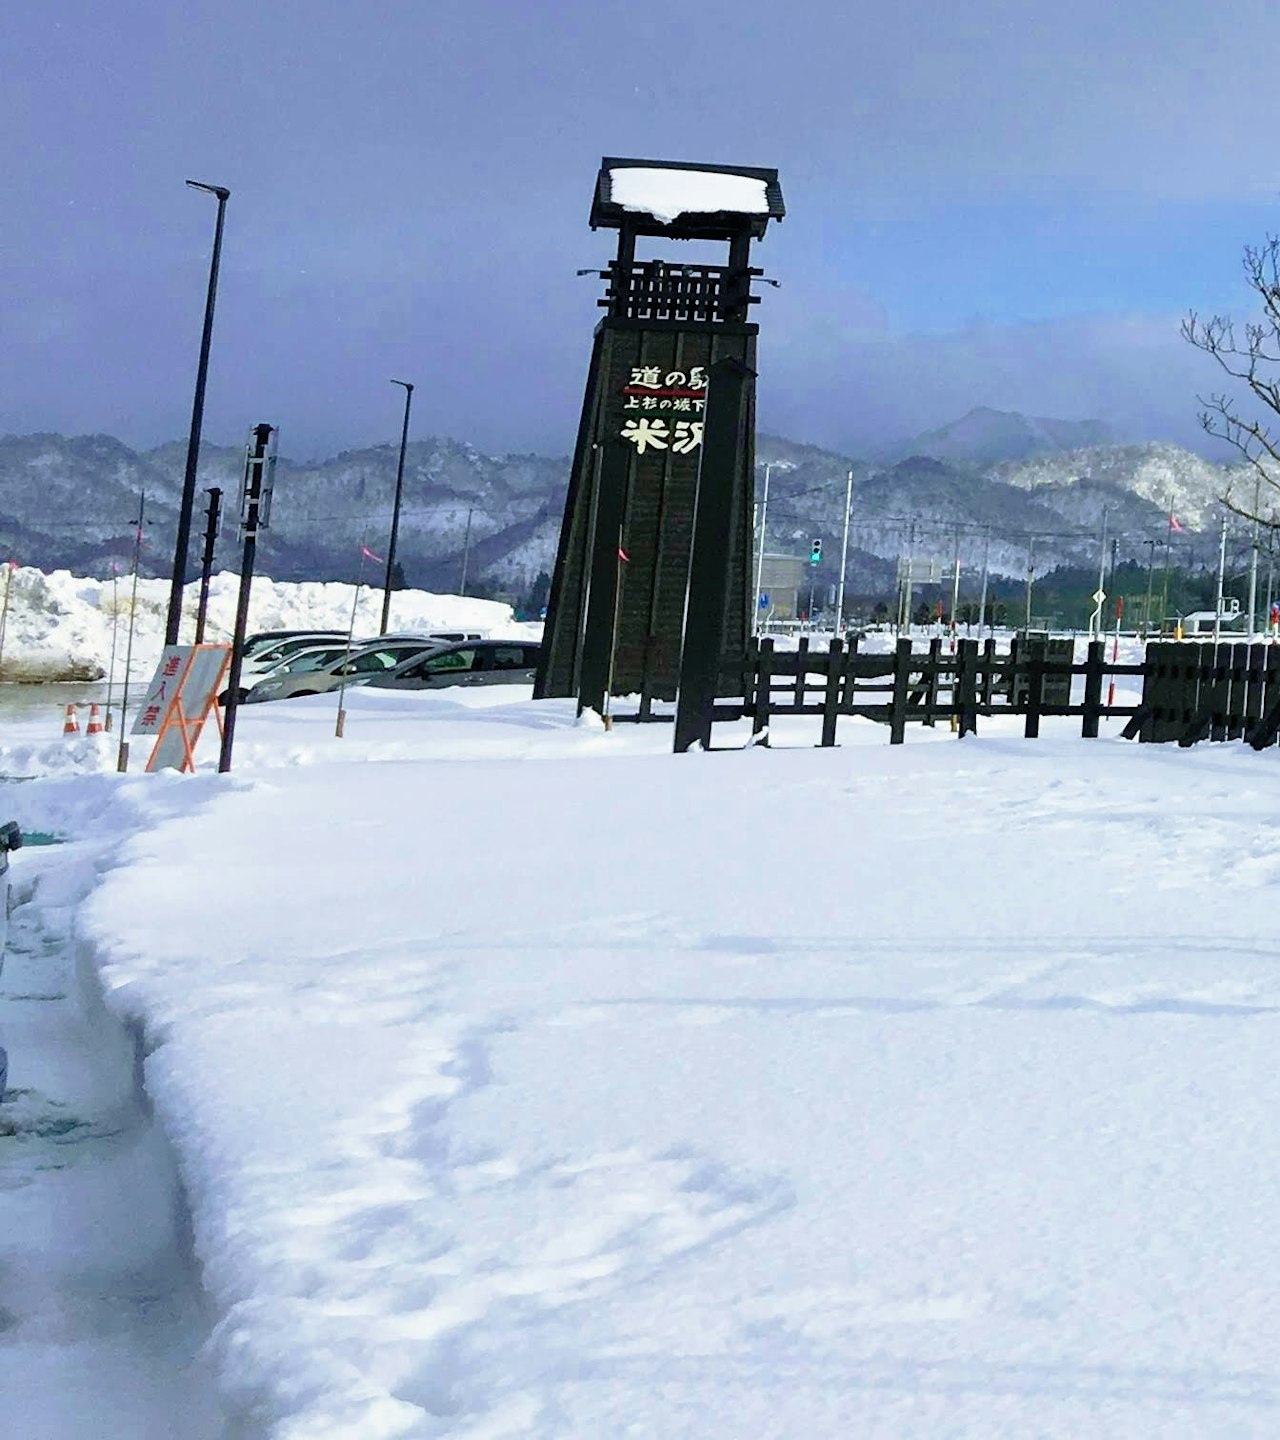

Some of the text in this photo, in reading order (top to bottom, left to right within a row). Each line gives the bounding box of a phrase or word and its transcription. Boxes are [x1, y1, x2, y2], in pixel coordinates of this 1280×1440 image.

[628, 365, 710, 390] 道の駅
[623, 395, 706, 413] 上杉の城下
[620, 417, 704, 455] 米沢
[141, 654, 182, 733] 進入禁
